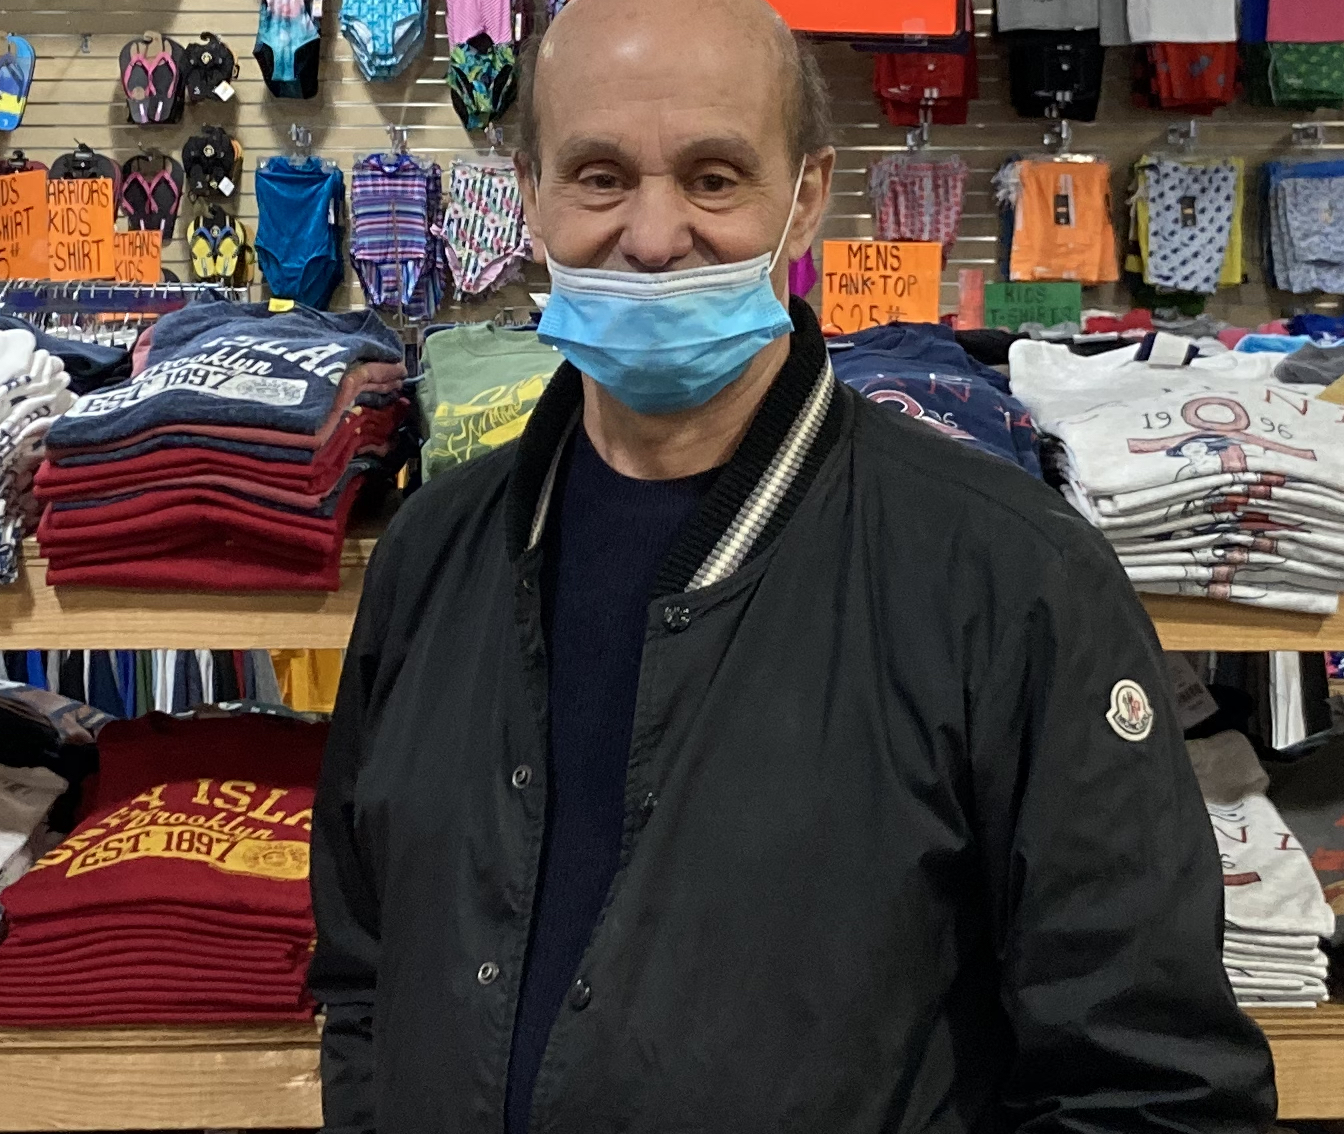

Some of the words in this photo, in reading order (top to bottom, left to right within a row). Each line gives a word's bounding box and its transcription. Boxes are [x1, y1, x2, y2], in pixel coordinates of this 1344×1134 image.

[47, 179, 110, 208] ARRIORS
[48, 239, 105, 273] -SHIRT
[114, 230, 160, 259] ATHAN'S
[848, 243, 903, 272] MENS
[162, 366, 235, 391] 1897
[1141, 411, 1173, 430] 19
[1259, 416, 1293, 439] 96
[191, 777, 316, 831] ISLA
[161, 827, 240, 864] 1897
